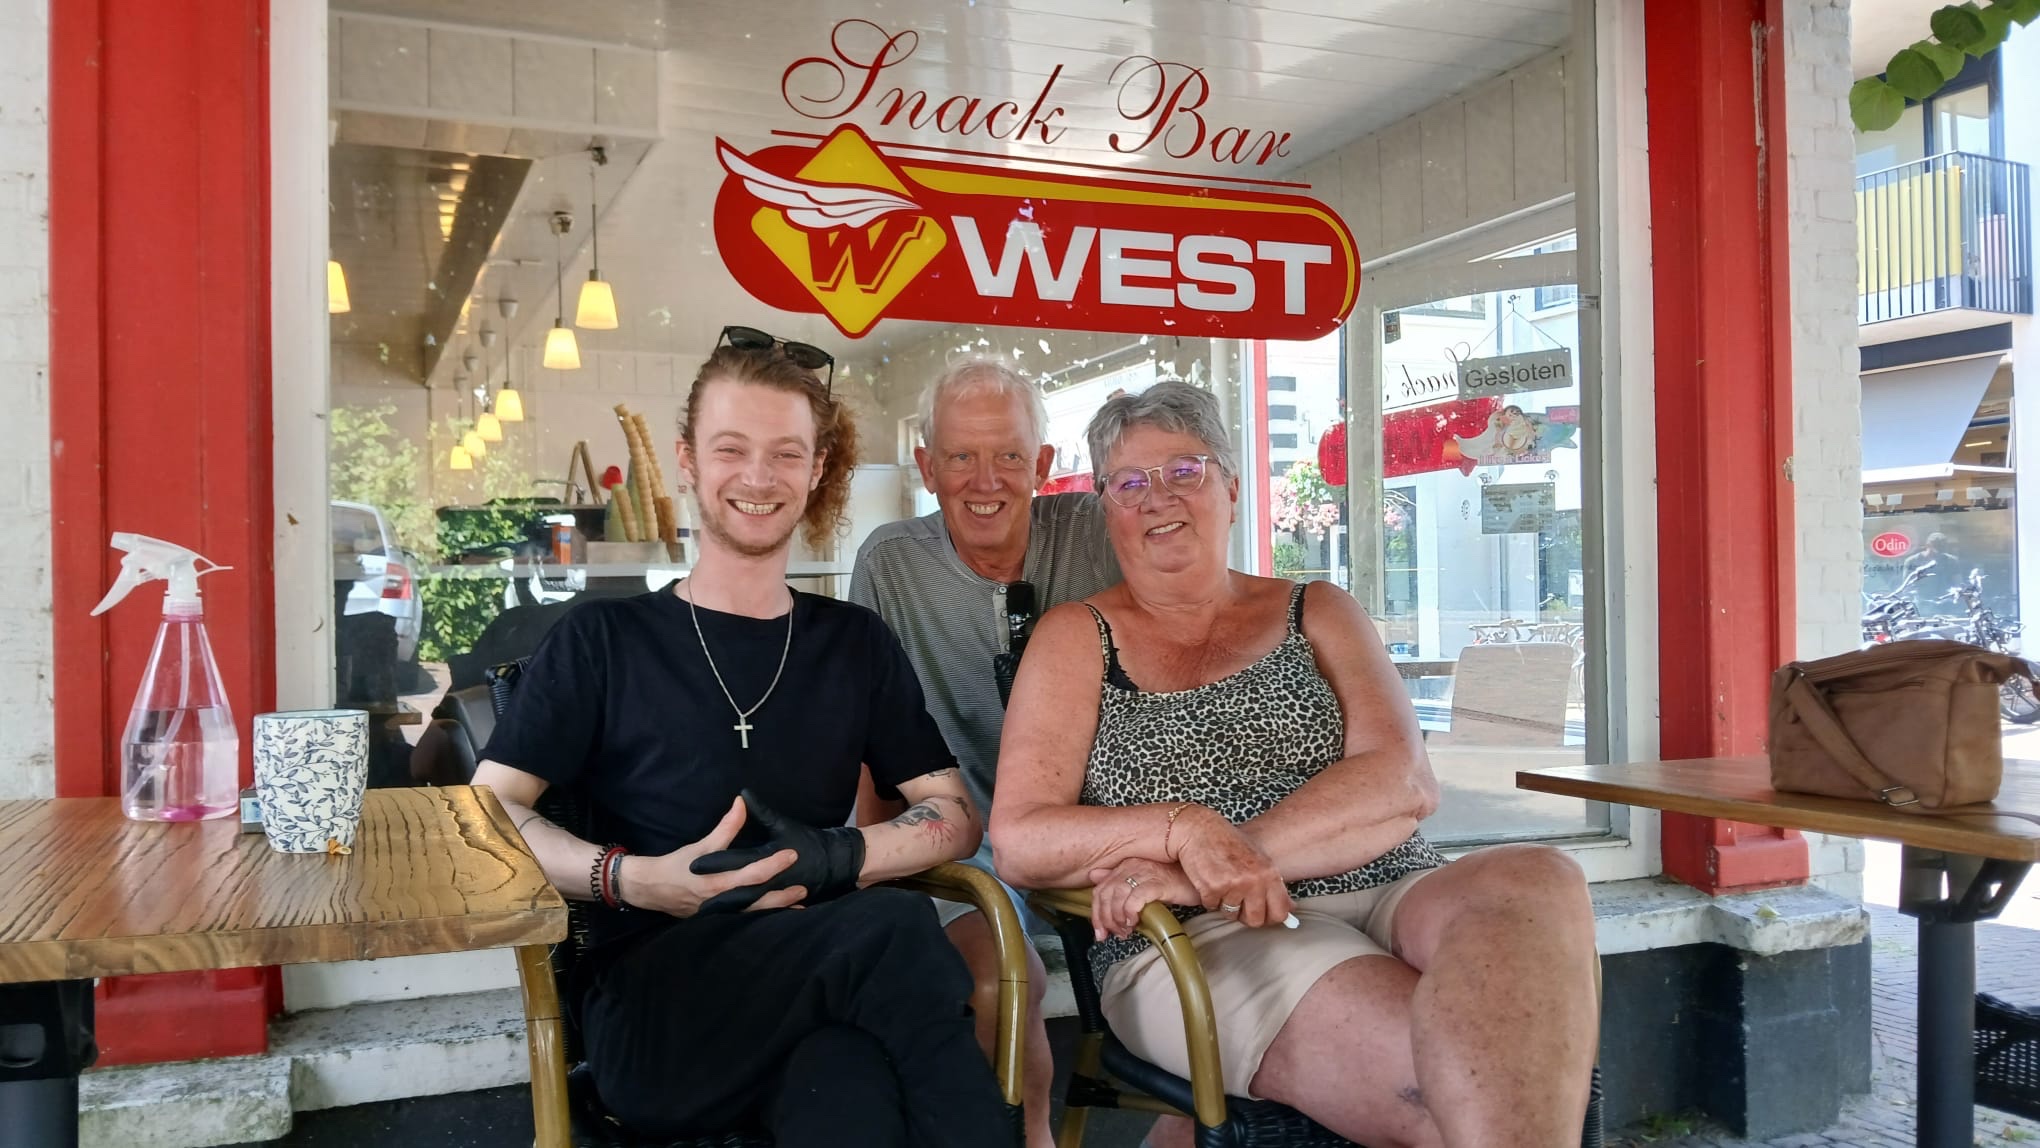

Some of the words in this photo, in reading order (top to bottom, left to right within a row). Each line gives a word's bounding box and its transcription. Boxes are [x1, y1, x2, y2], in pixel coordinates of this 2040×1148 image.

[782, 19, 1067, 143] Snack
[1107, 55, 1291, 165] Bar
[951, 214, 1332, 315] WEST
[1465, 363, 1566, 388] Gesloten
[1875, 538, 1906, 552] Odin
